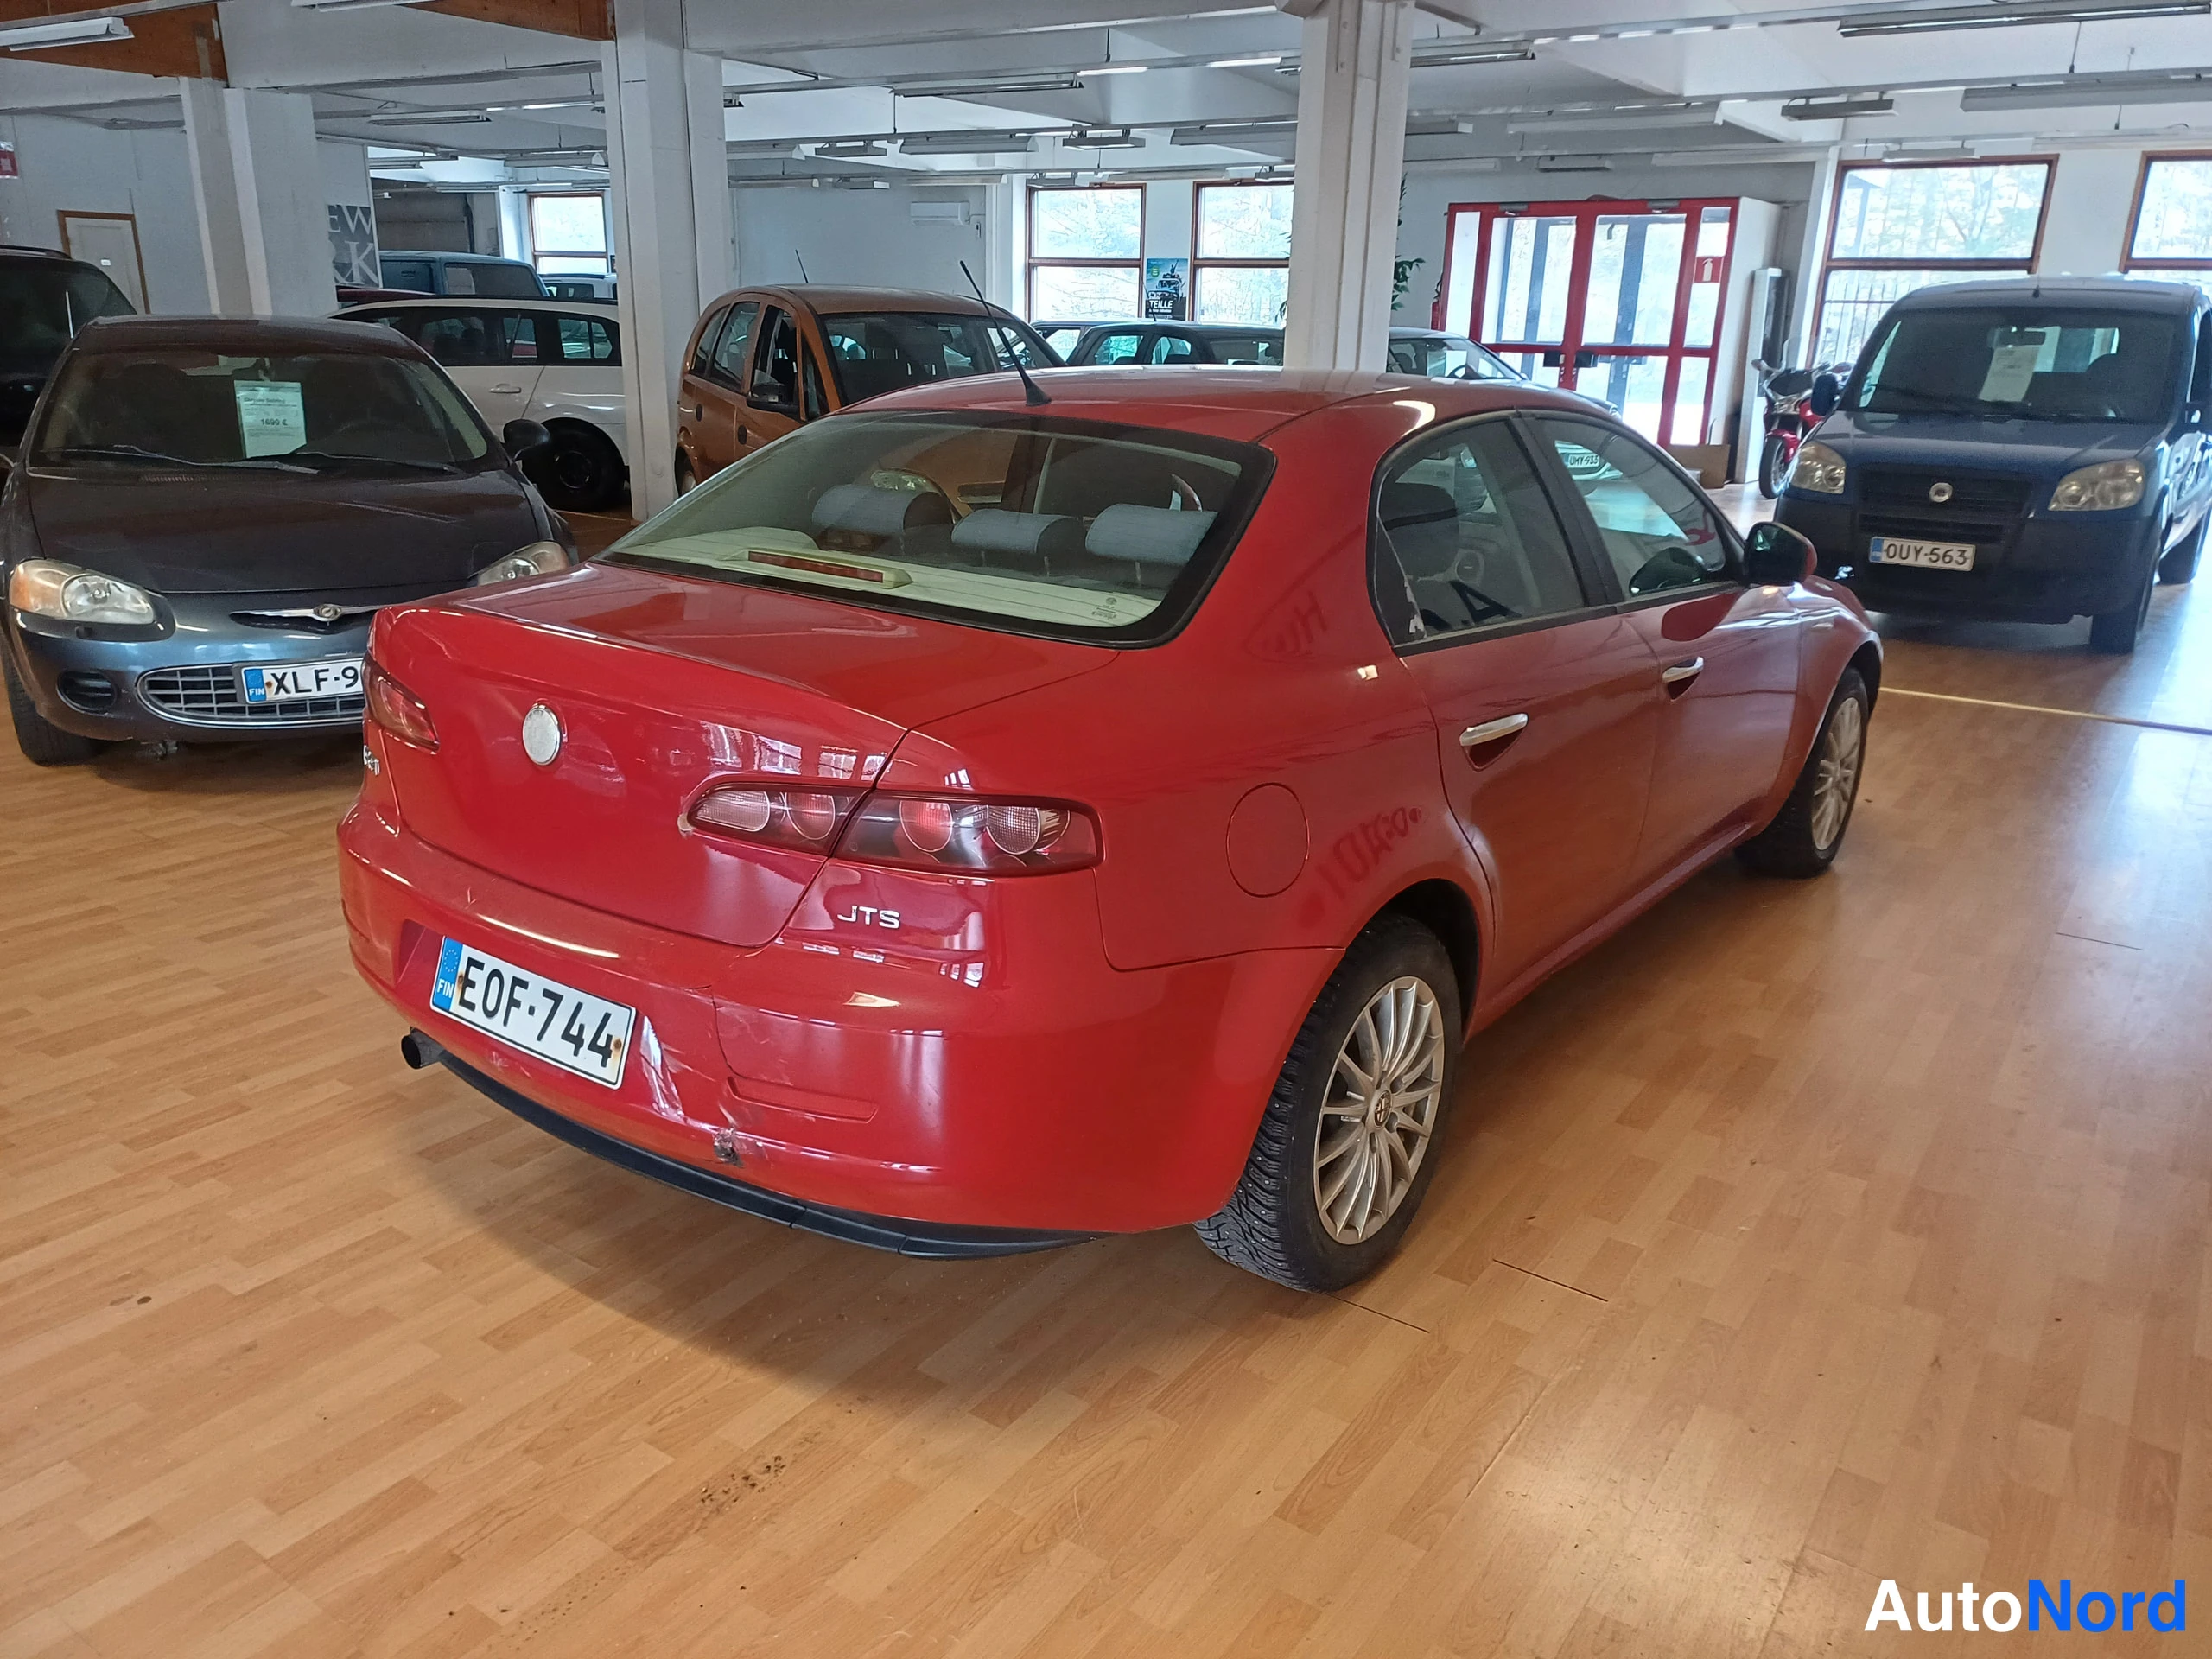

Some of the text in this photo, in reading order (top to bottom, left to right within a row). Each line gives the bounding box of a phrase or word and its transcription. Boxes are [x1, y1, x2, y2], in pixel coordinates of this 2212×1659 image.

[328, 204, 373, 235] EW
[1149, 300, 1173, 309] TEILLE
[1885, 543, 1968, 566] OUY-563
[249, 687, 265, 697] FIN
[270, 665, 359, 696] XLF-9
[836, 905, 900, 930] JTS
[436, 978, 454, 999] FIN
[458, 956, 614, 1069] EOF-744
